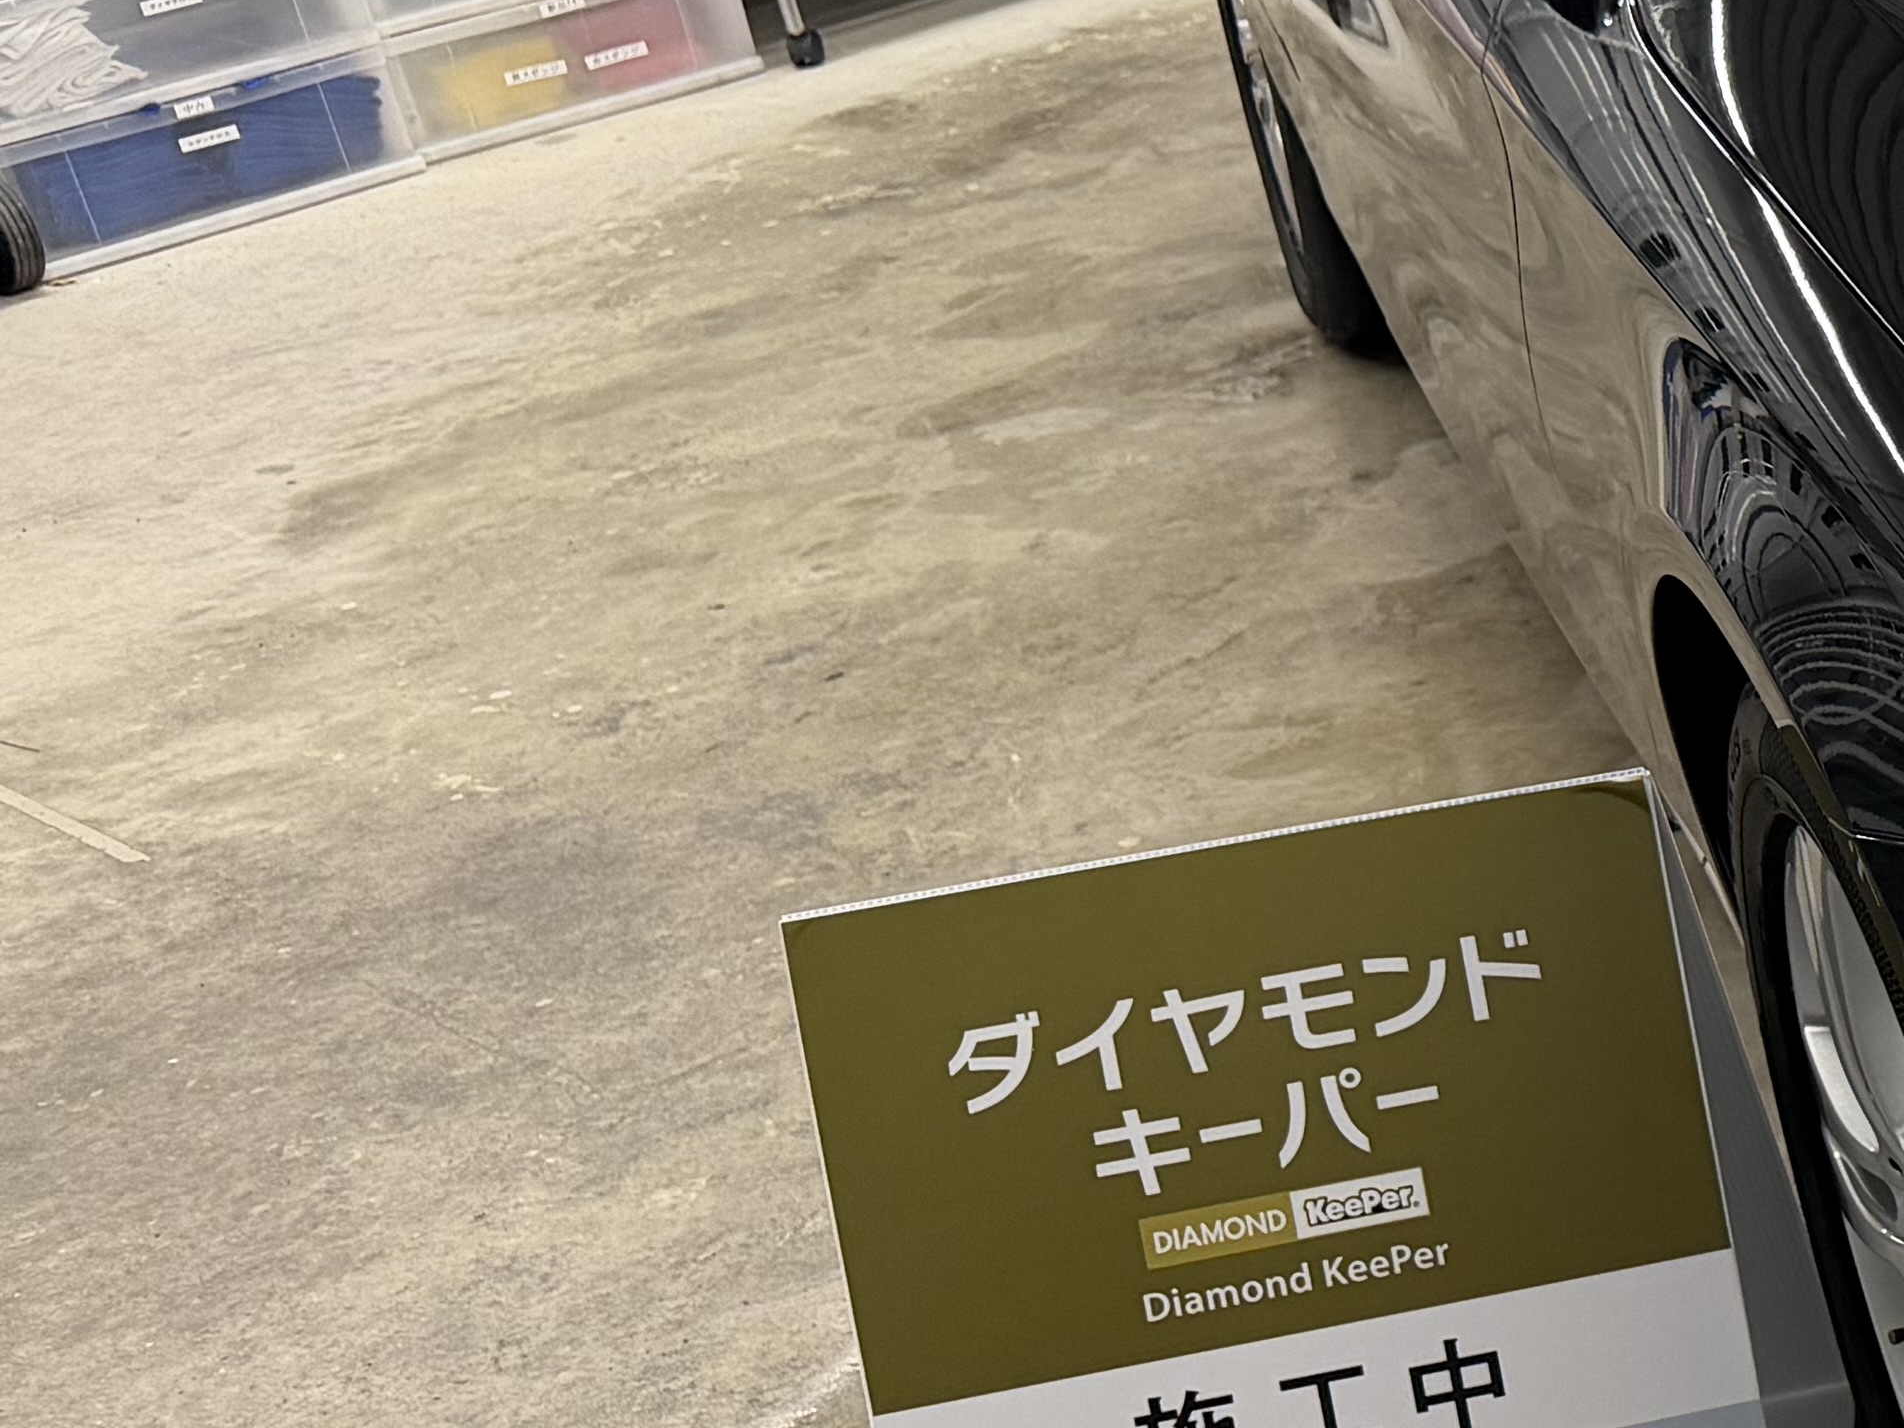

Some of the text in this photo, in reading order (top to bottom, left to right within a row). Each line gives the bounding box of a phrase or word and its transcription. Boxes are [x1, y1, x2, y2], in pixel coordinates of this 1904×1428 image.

[947, 929, 1542, 1114] ダイヤモンド
[1092, 1067, 1441, 1196] キーパー
[1152, 1185, 1415, 1255] DIAMOND KeePer
[1142, 1242, 1450, 1323] Diamond KeePer
